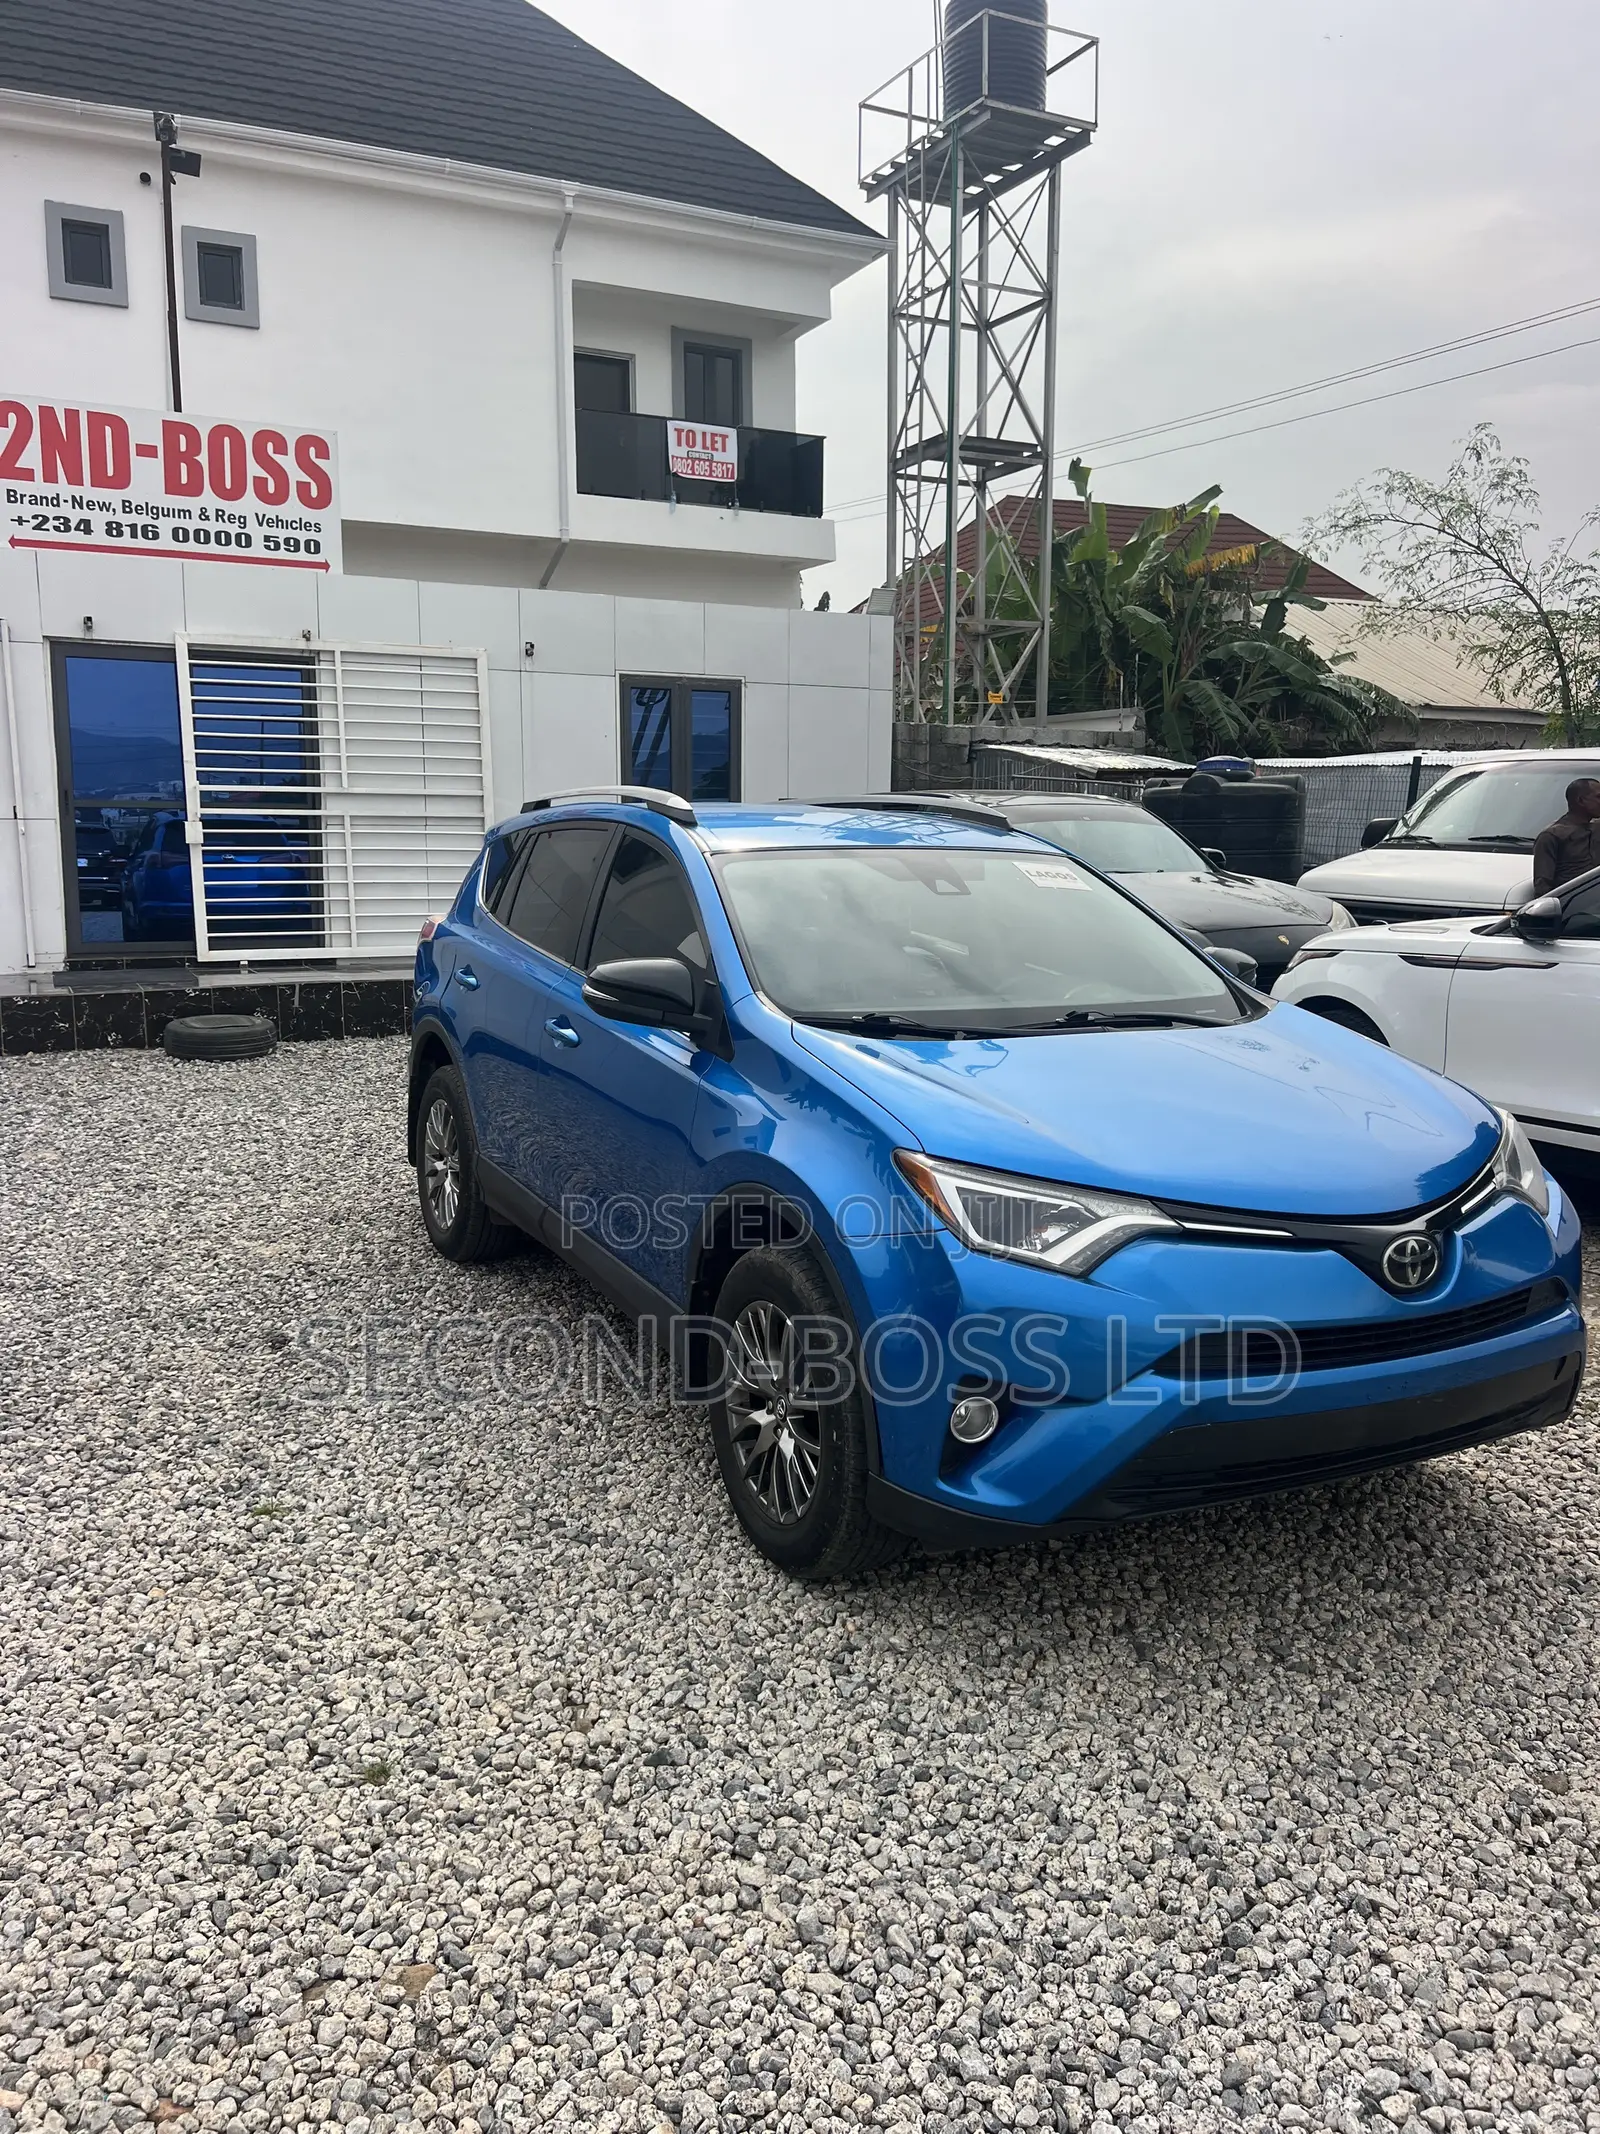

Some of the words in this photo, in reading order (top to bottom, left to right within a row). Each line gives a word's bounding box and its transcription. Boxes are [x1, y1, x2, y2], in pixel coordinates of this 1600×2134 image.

[0, 400, 333, 510] 2ND-BOSS
[674, 428, 696, 449] TO
[702, 432, 729, 453] LET
[694, 461, 710, 476] 605
[712, 463, 733, 478] 5817
[6, 488, 117, 516] Brand-New,
[121, 499, 193, 521] Belguim
[198, 506, 211, 522] &
[215, 508, 247, 529] Reg
[255, 512, 322, 533] Vehicles
[10, 513, 94, 536] +234
[105, 521, 160, 541] 816
[172, 526, 253, 549] 0000
[263, 534, 321, 555] 590
[1025, 869, 1078, 881] LAGOS
